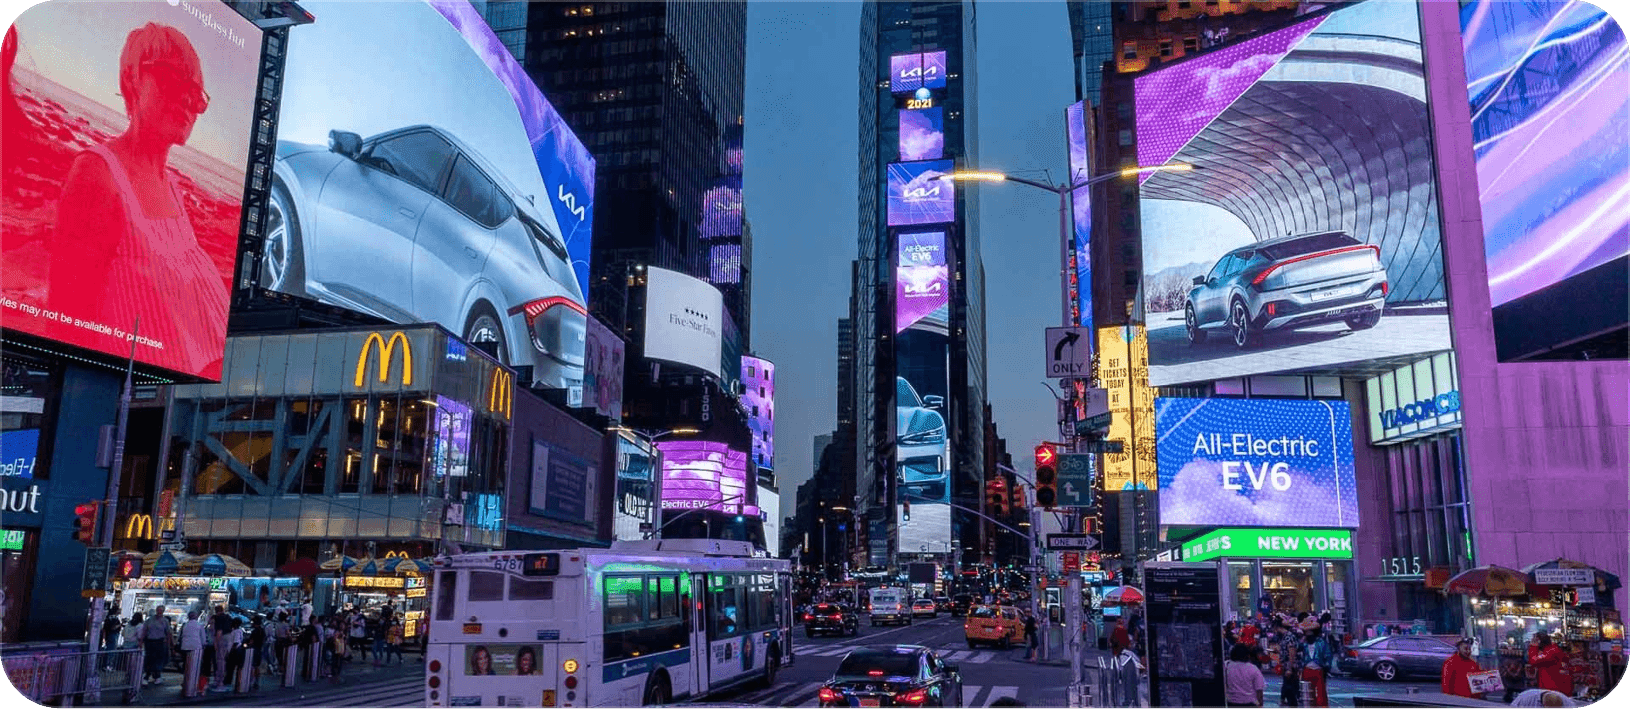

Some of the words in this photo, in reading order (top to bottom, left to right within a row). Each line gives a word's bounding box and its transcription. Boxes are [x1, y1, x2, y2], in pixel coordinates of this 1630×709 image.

[907, 98, 932, 109] 2021
[19, 303, 41, 318] may
[42, 309, 59, 321] not
[60, 312, 73, 324] be
[74, 318, 112, 335] available
[113, 327, 126, 339] for
[1053, 362, 1085, 375] ONLY
[1108, 358, 1120, 369] GET
[1102, 367, 1128, 380] TICKETS
[1105, 379, 1125, 390] TODAY
[1192, 432, 1320, 458] All-Electric
[1221, 460, 1293, 493] EV6
[625, 493, 637, 516] OLD
[661, 499, 691, 510] Electric
[1053, 538, 1070, 546] ONE
[1080, 538, 1094, 546] WAY
[1257, 536, 1300, 551] NEW
[1304, 537, 1352, 551] YORK
[493, 558, 525, 571] 6787
[1381, 556, 1421, 576] 1515
